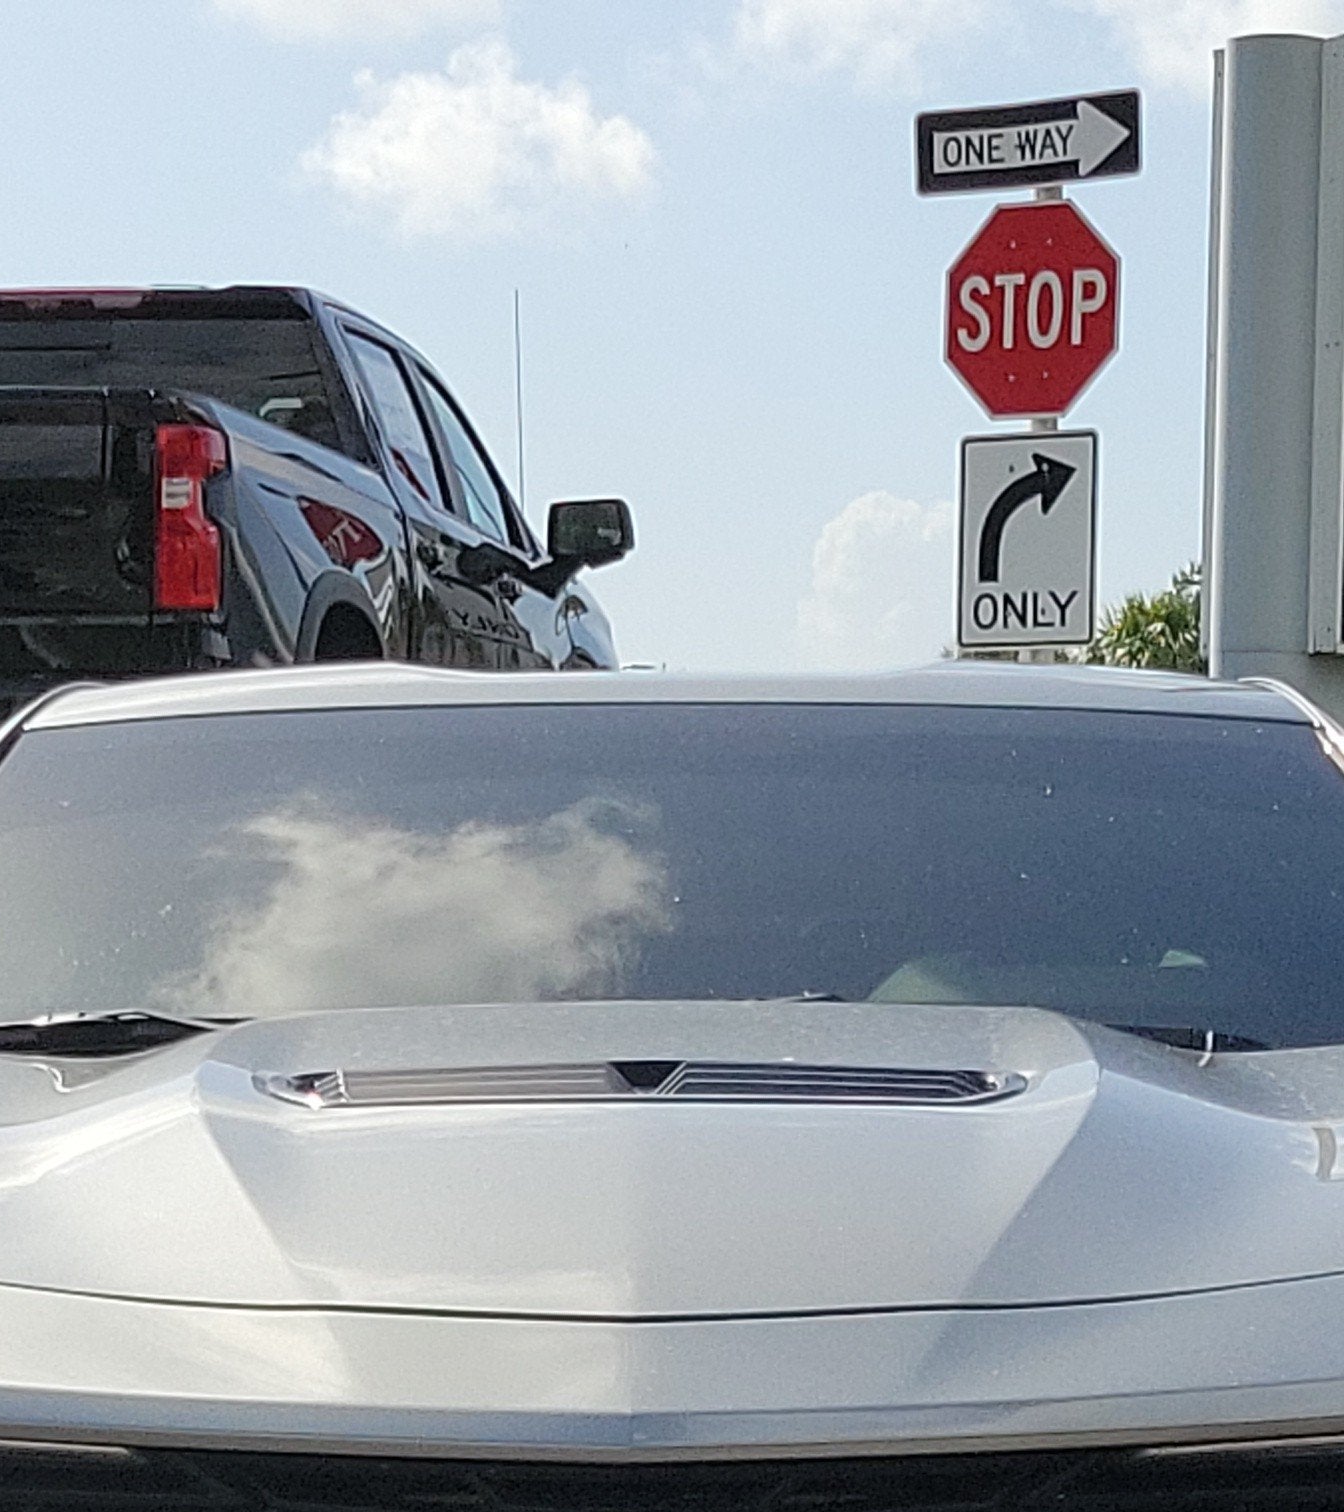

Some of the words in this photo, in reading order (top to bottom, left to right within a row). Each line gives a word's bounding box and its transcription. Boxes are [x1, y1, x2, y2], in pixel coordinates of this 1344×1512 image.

[943, 133, 1005, 168] ONE
[1015, 125, 1074, 161] WAY
[957, 268, 1108, 353] STOP
[973, 589, 1078, 630] ONLY
